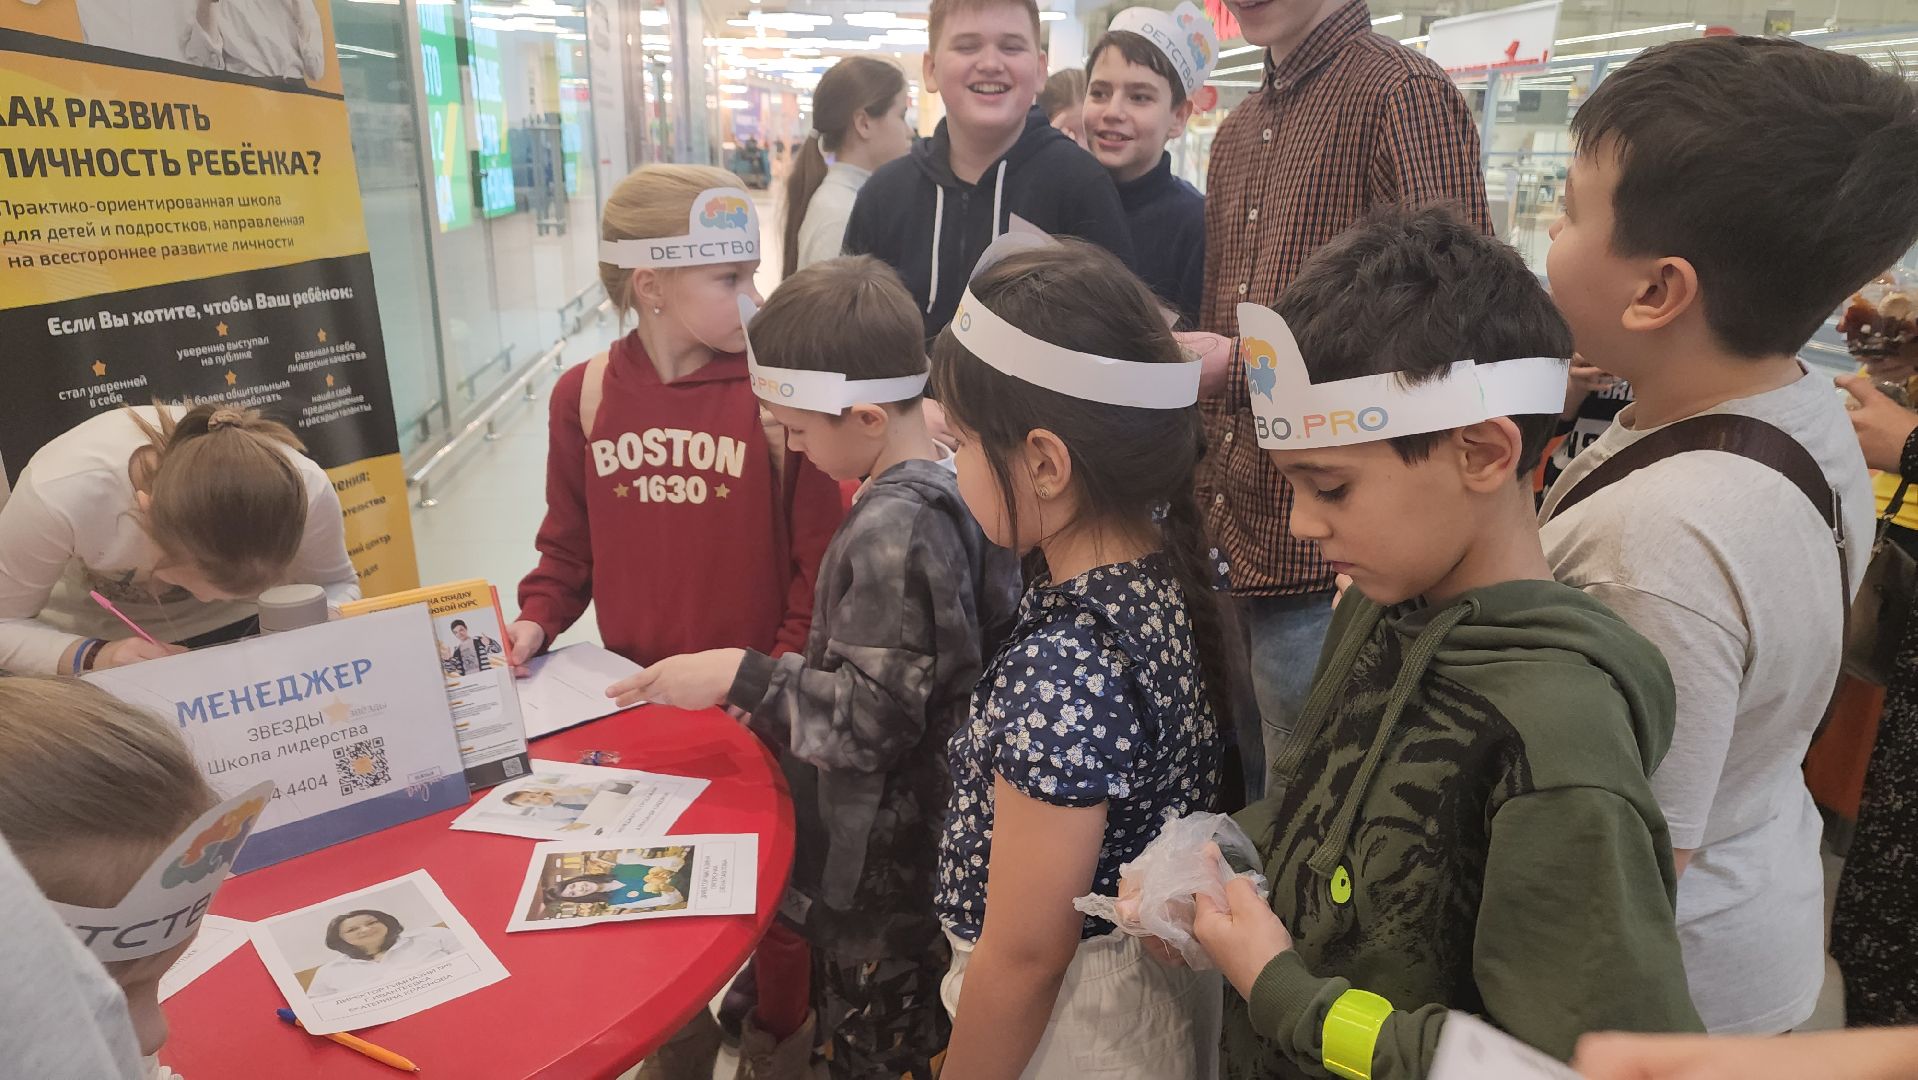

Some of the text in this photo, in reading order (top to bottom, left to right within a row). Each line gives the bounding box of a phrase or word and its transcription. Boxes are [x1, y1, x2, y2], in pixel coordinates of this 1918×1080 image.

[64, 98, 211, 131] РАЗВИТЬ
[188, 142, 322, 177] РЕБЁНКА?
[0, 195, 282, 220] Практико-ориентированная школа
[3, 215, 305, 246] для детей и подростков, направленная
[8, 237, 295, 269] на всестороннее развитие личности
[47, 285, 354, 336] Если Вы хотите, чтобы Ваш ребёнок:
[176, 335, 270, 361] уверенно выступал
[201, 356, 214, 367] на
[335, 341, 357, 353] себе
[58, 387, 87, 400] стал
[97, 392, 124, 407] себе
[194, 391, 225, 406] более
[225, 380, 291, 400] общительным
[591, 427, 747, 479] BOSTON
[632, 475, 708, 504] 1630
[431, 602, 458, 615] ЮБОЙ
[175, 658, 373, 728] МЕНЕДЖЕР
[247, 711, 325, 742] ЗВЕЗДЫ
[208, 724, 369, 775] Школа лидерства
[287, 773, 329, 796] 4404
